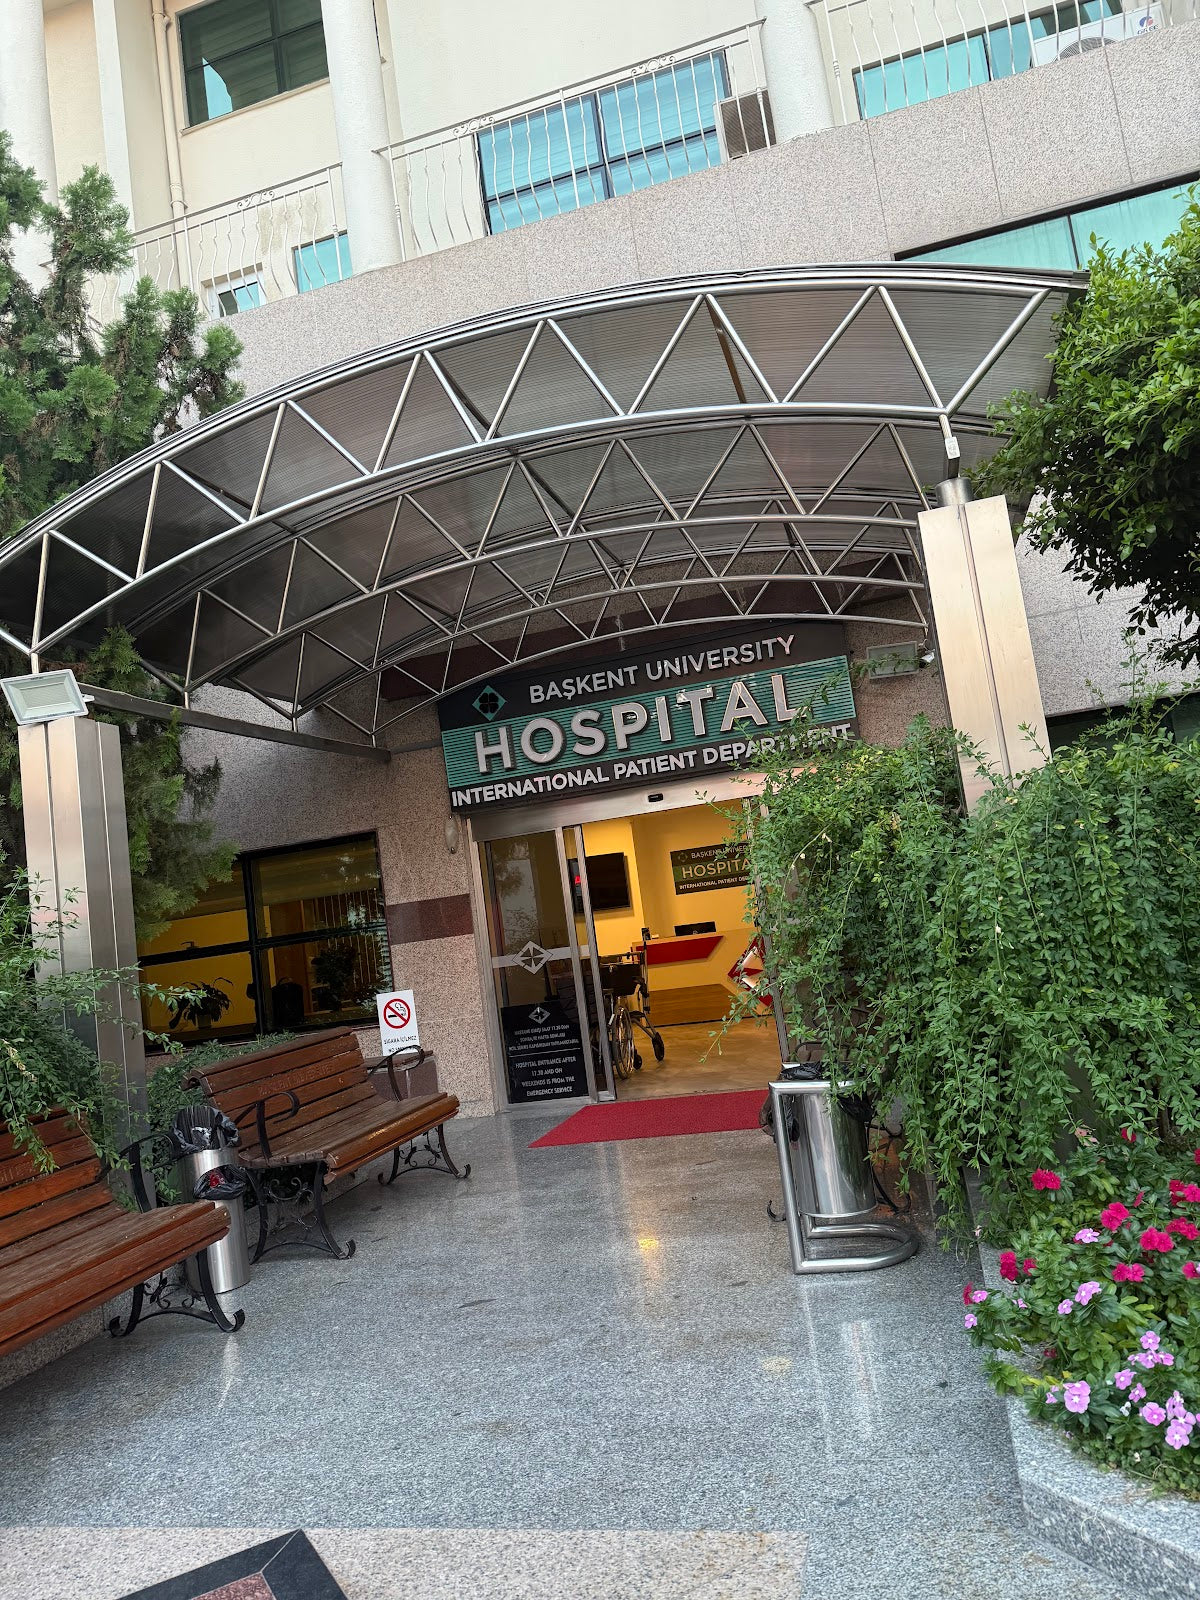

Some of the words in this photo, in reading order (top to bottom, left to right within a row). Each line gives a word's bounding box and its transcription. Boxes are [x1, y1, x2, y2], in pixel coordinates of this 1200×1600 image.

[529, 664, 640, 704] BAŞKENT
[646, 634, 796, 681] UNIVERSITY
[474, 673, 808, 775] HOSPITAL
[451, 767, 610, 808] INTERNATIONAL
[613, 749, 698, 780] PATIENT
[679, 880, 718, 890] INTERNATIONAL
[682, 858, 751, 879] HOSPITA
